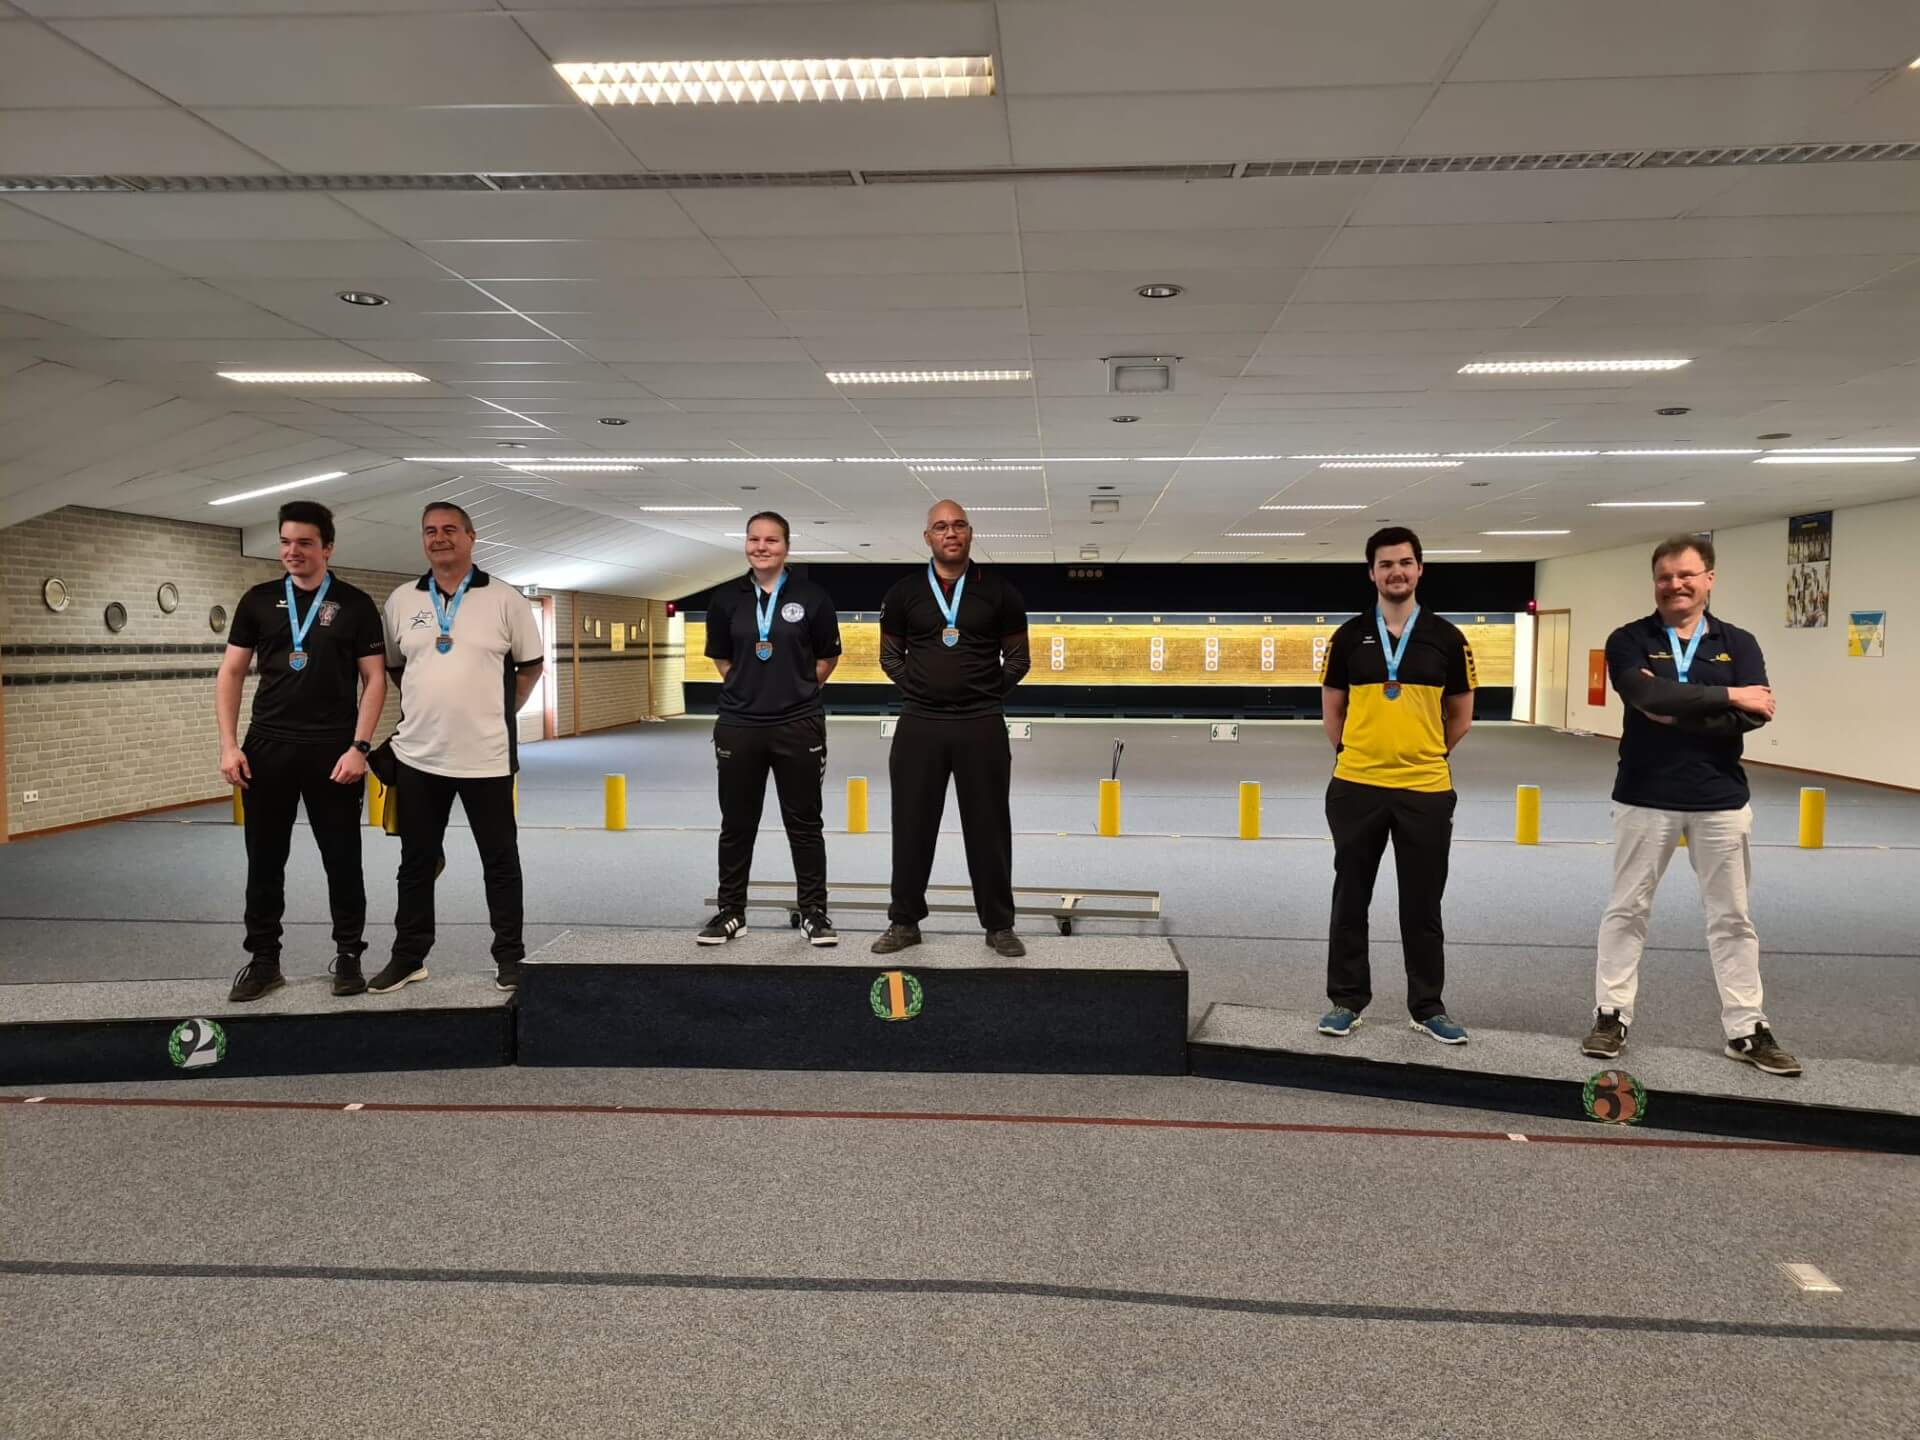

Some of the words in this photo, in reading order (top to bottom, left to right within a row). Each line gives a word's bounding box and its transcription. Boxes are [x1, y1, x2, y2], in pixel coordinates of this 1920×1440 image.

[1212, 727, 1218, 738] 6
[881, 971, 907, 1020] 1
[180, 1018, 218, 1069] 2
[1593, 1069, 1637, 1123] 3
